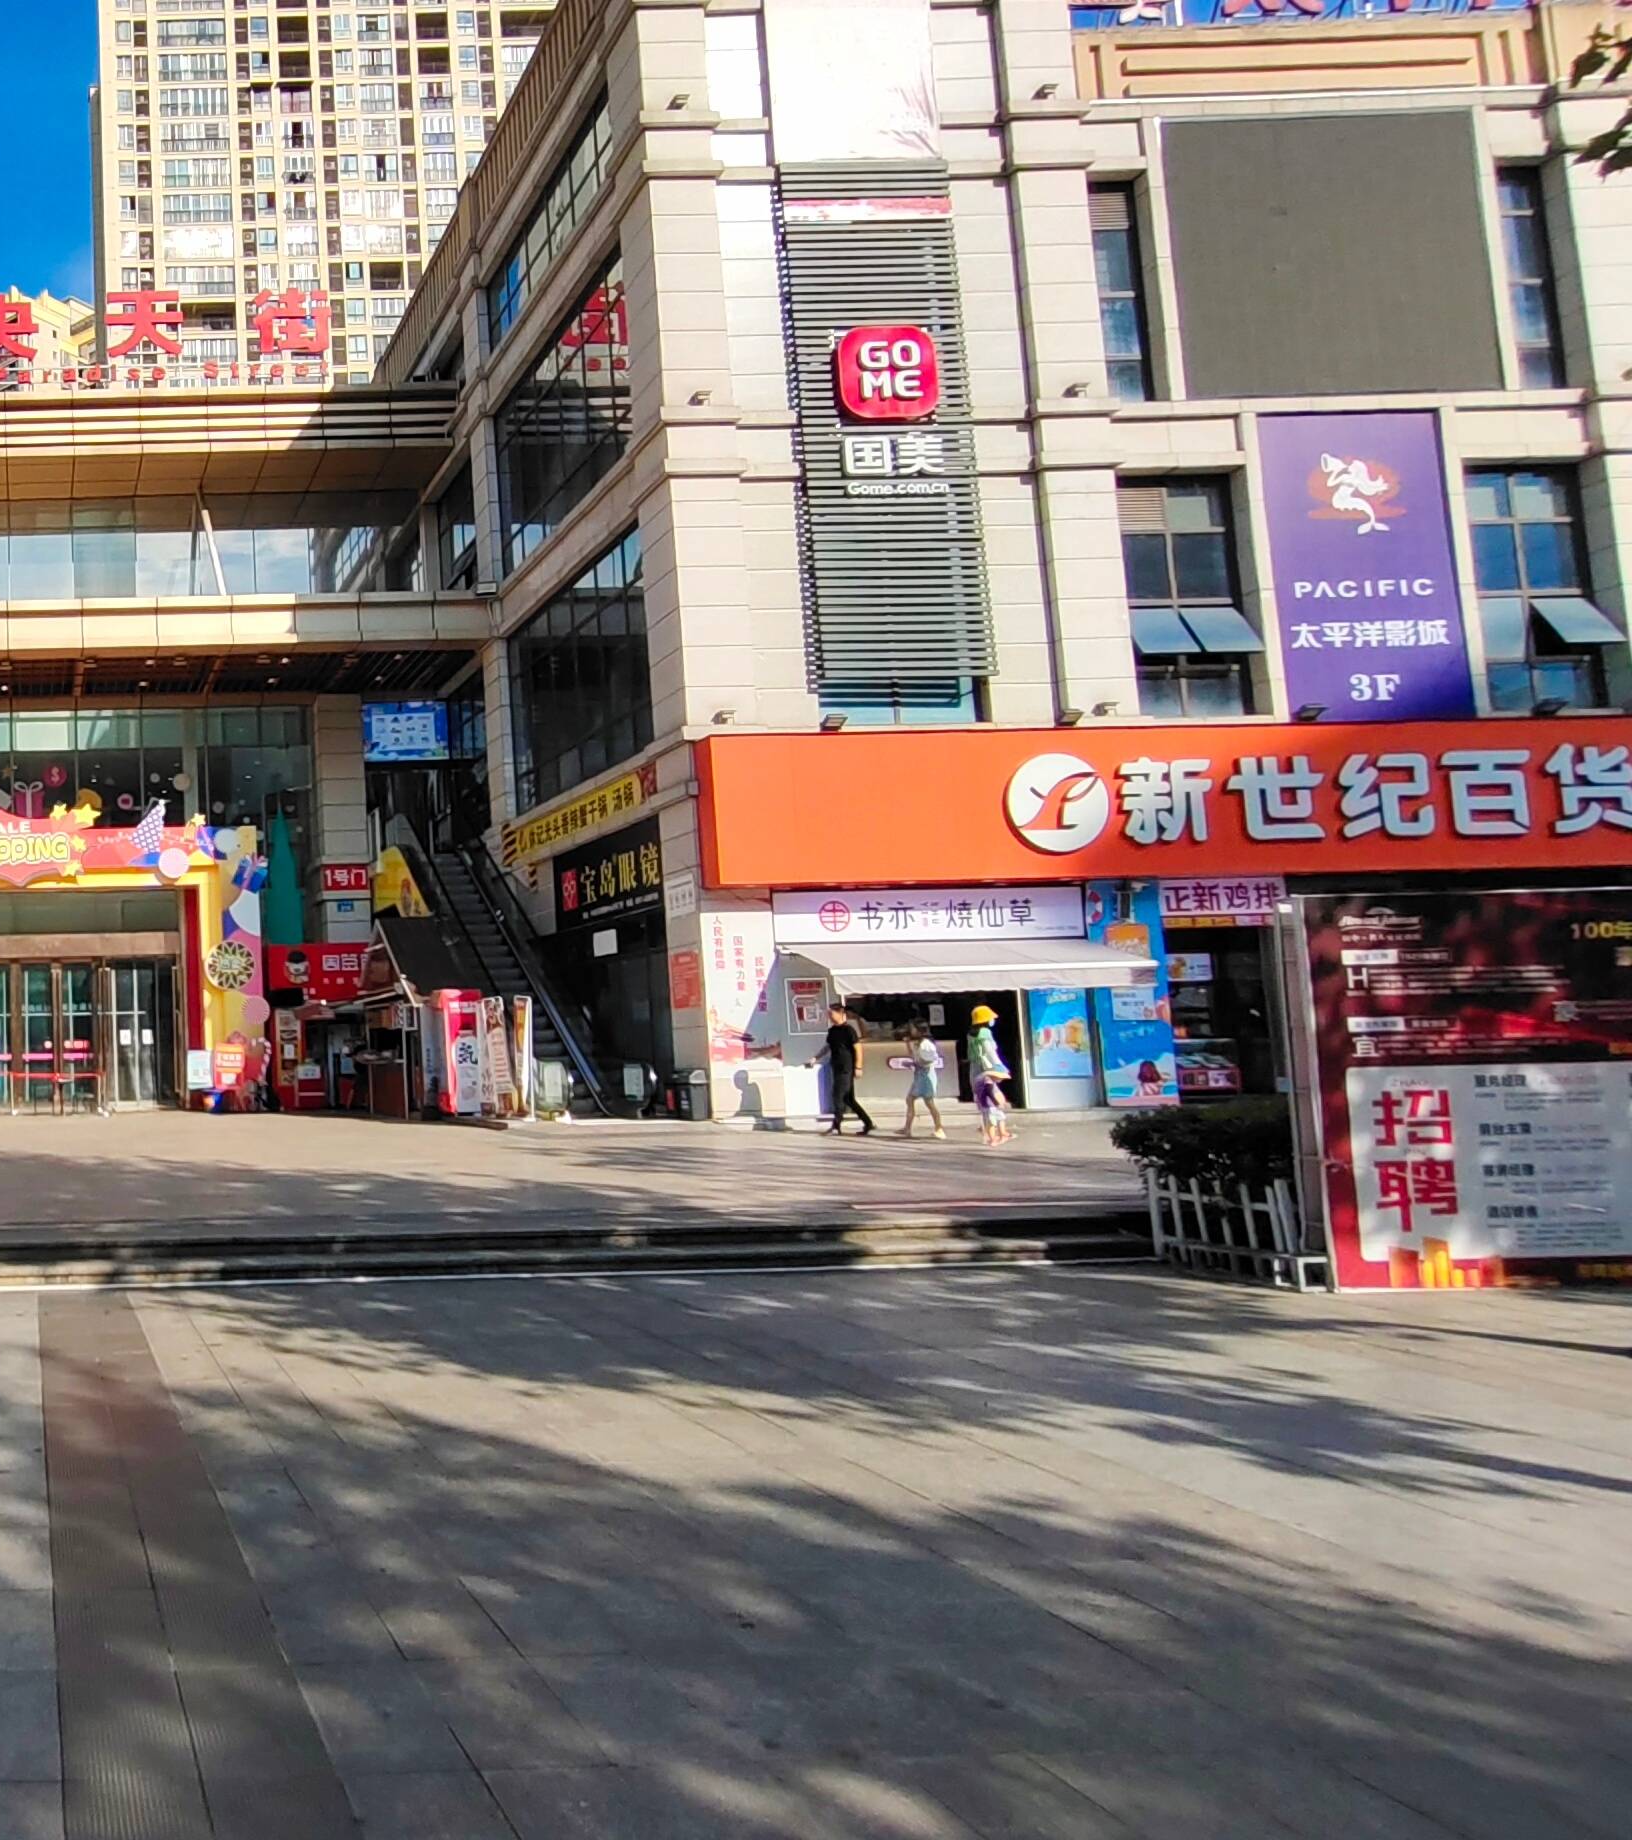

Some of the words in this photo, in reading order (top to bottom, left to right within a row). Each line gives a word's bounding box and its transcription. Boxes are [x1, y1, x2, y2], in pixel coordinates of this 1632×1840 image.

[203, 358, 331, 380] Street
[844, 432, 946, 476] 国美
[847, 482, 950, 496] Gome.com.cn
[1294, 578, 1435, 599] PACIFIC
[1290, 618, 1451, 649] 太平洋影城
[1348, 673, 1401, 702] 3F
[1119, 742, 1632, 845] 新世纪百货
[325, 868, 367, 887] 1号门
[580, 842, 661, 904] 宝岛眼镜
[1161, 881, 1280, 912] 正新鸡排
[857, 901, 916, 930] 书亦
[1372, 1089, 1459, 1233] 招聘
